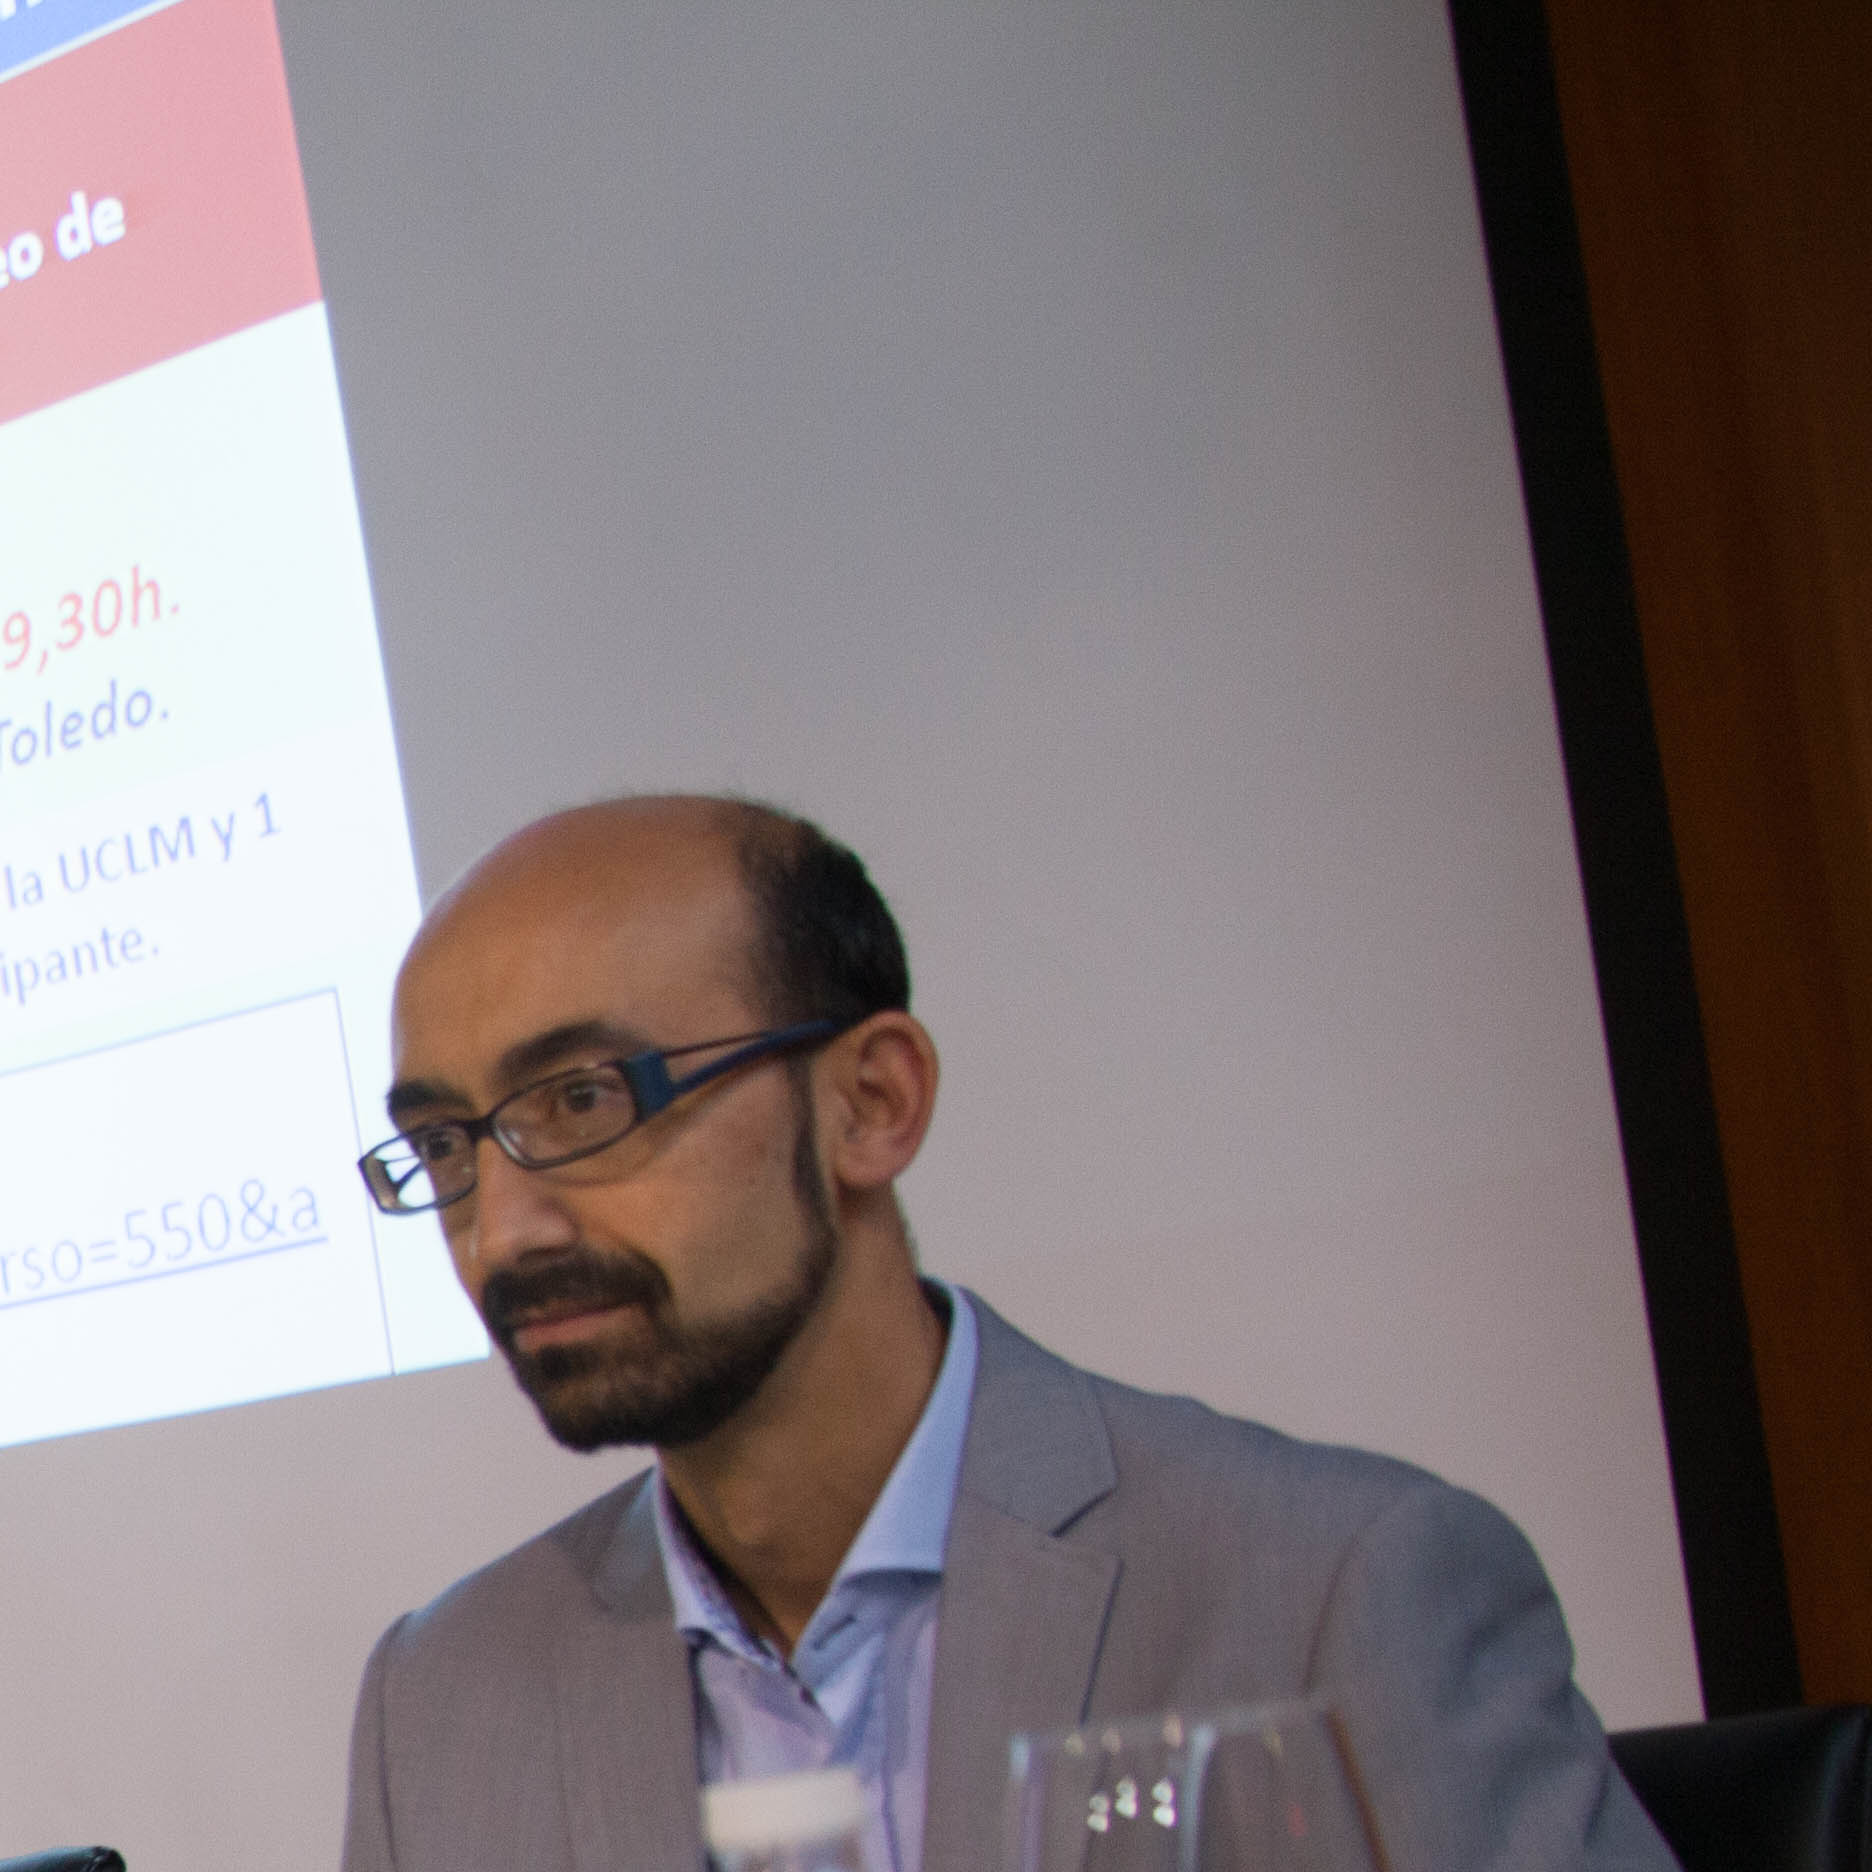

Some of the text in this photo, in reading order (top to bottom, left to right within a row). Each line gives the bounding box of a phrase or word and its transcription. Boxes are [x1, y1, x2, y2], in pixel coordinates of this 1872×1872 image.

[55, 189, 126, 261] de
[4, 864, 45, 911] la
[58, 815, 197, 894] UCLM
[210, 810, 236, 862] y
[253, 792, 282, 838] 1
